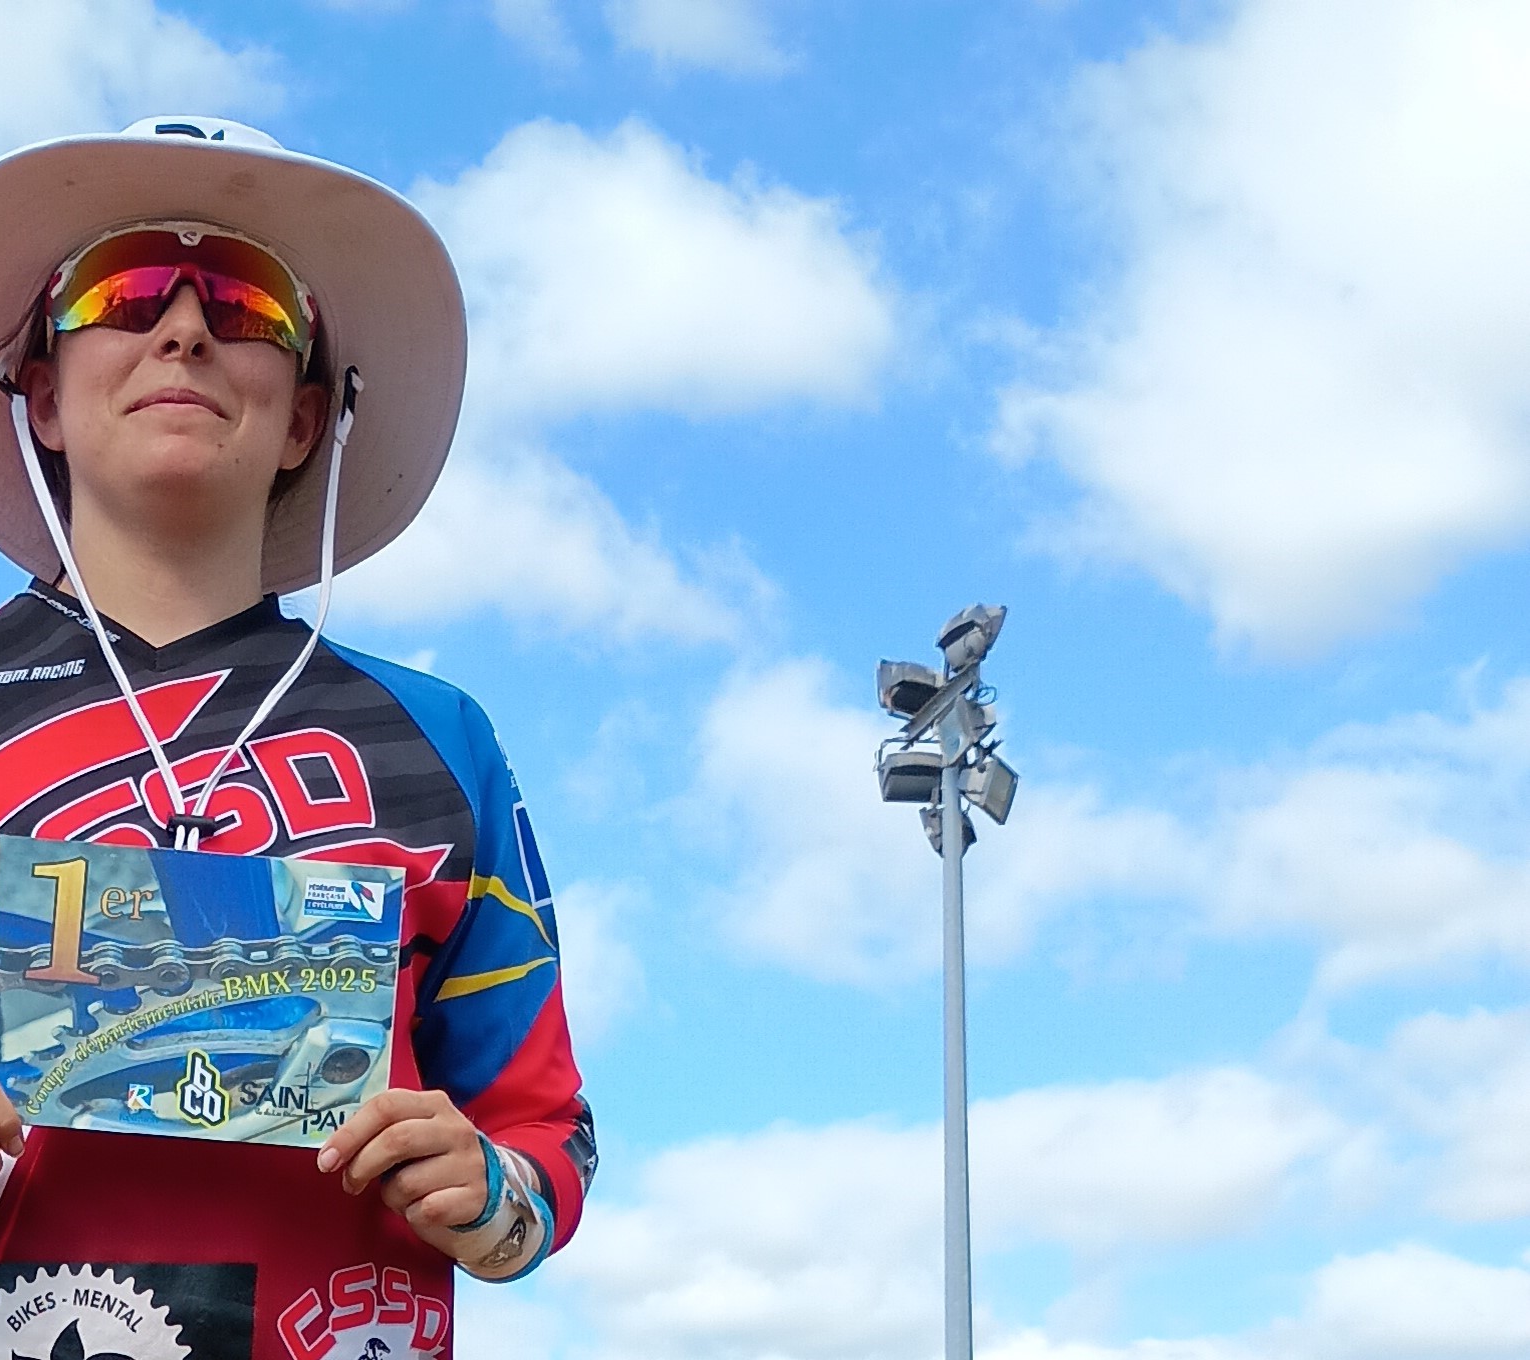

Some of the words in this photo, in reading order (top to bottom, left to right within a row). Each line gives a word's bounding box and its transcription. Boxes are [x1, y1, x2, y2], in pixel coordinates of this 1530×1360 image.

[221, 970, 291, 1002] BMX
[300, 967, 377, 994] 2025
[6, 1290, 57, 1333] BIKES
[72, 1287, 144, 1334] MENTAL
